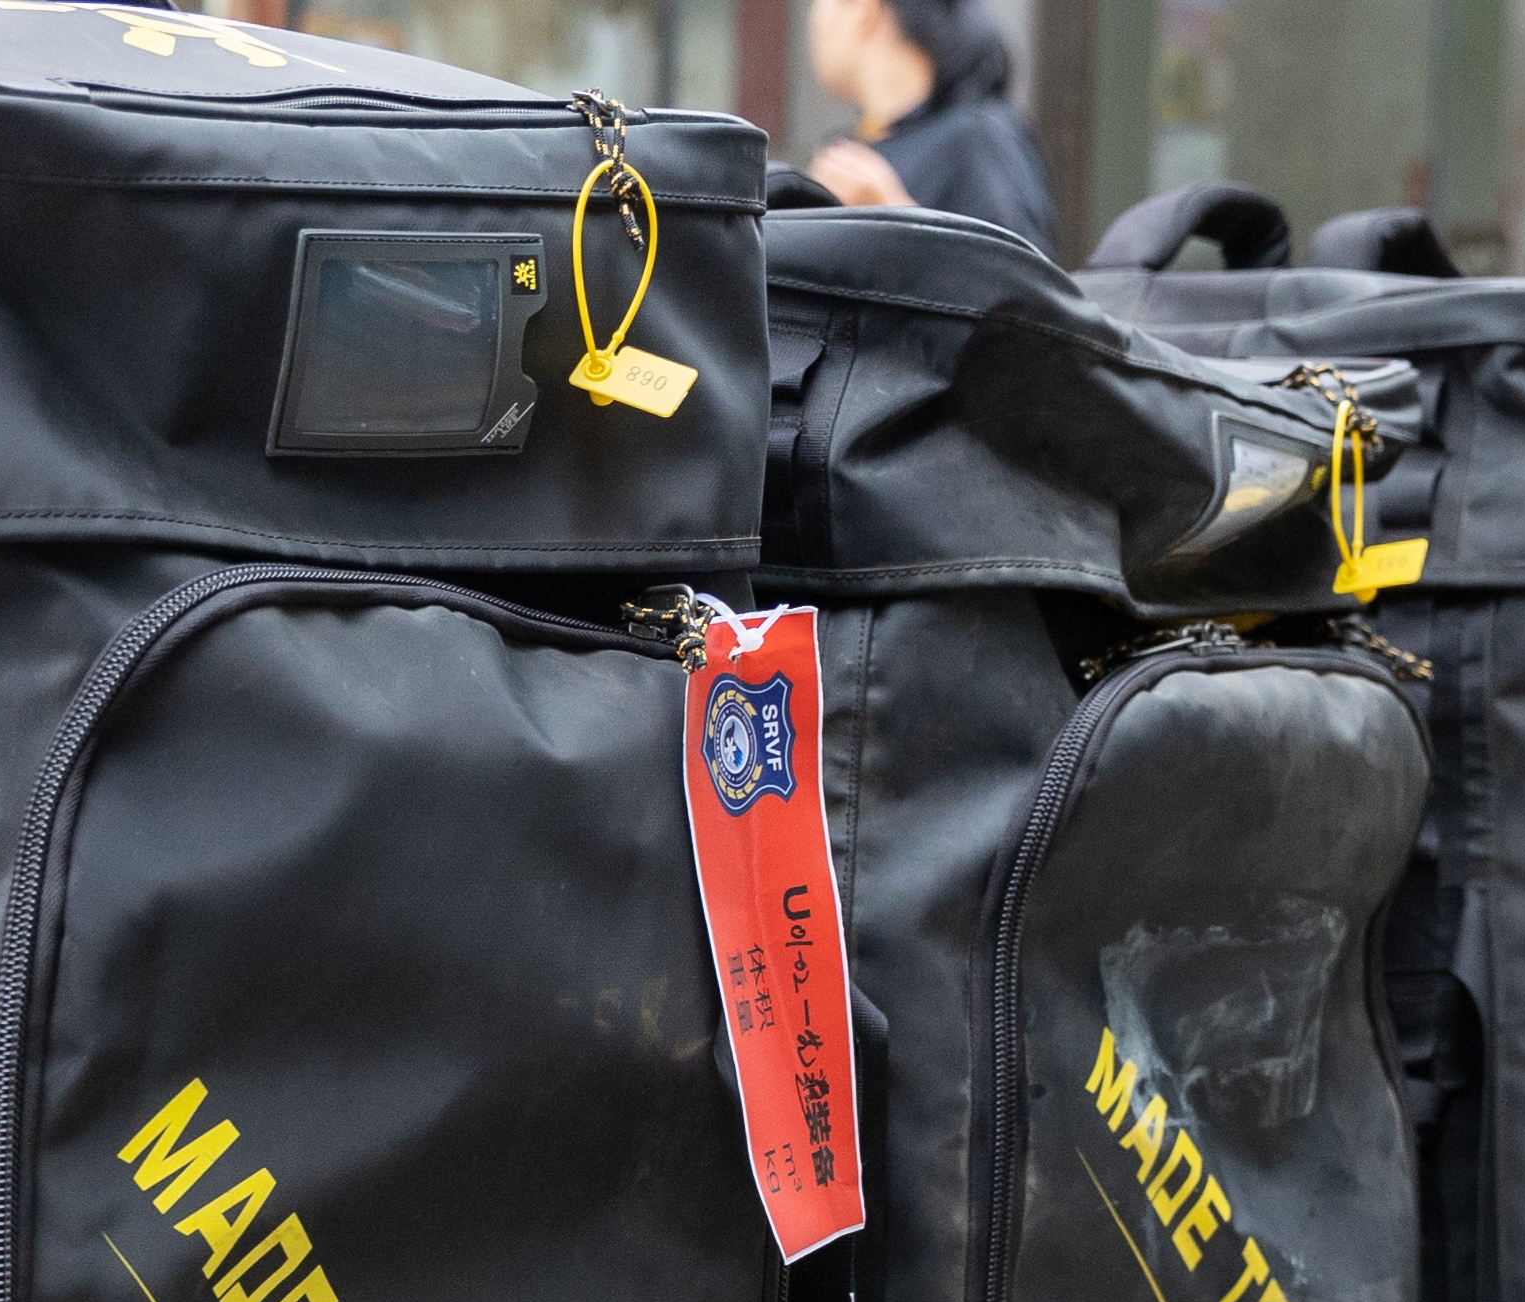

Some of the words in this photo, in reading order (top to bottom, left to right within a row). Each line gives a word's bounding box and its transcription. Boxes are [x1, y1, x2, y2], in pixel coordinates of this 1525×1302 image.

[626, 366, 667, 390] 890
[762, 703, 783, 772] SRVF
[747, 943, 775, 1031] 体积
[726, 952, 754, 1035] 重量
[763, 1150, 781, 1194] kg
[1085, 1027, 1231, 1271] MADE
